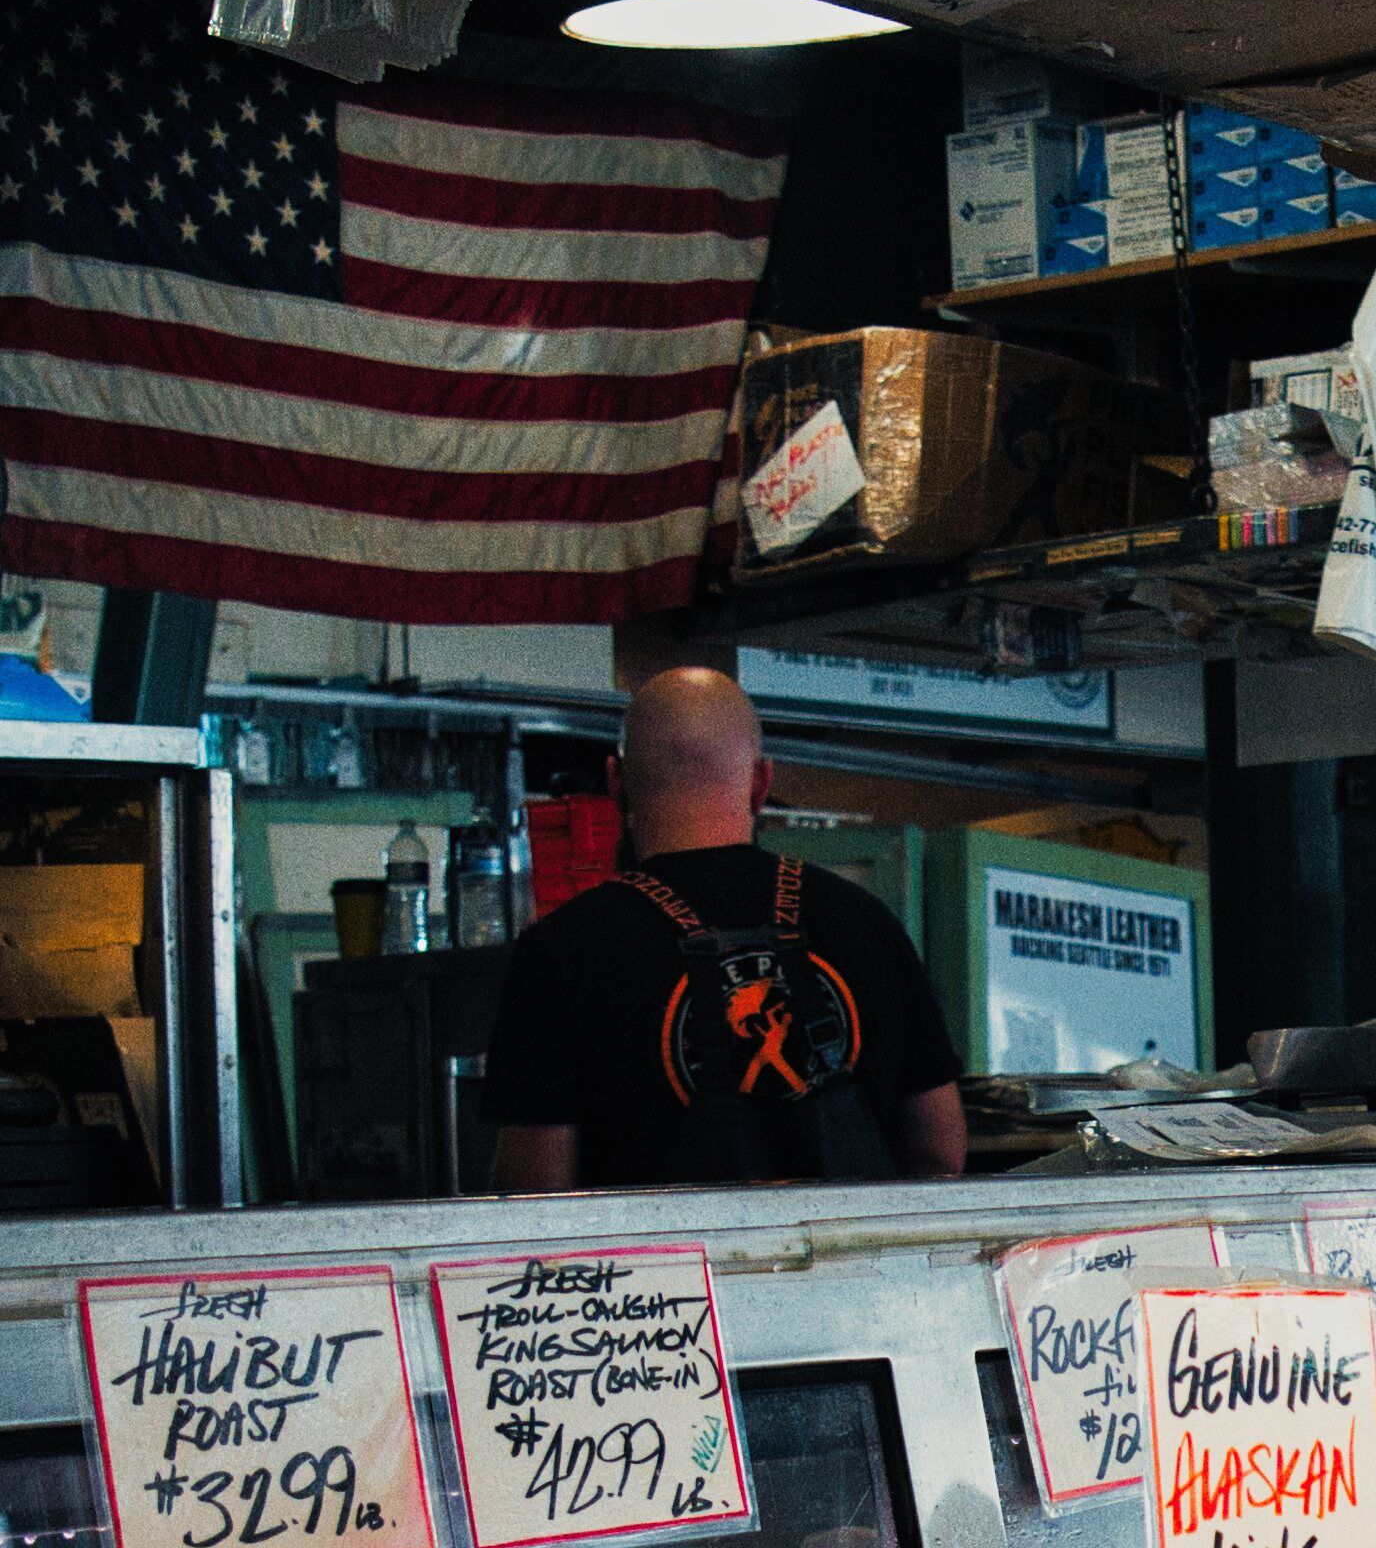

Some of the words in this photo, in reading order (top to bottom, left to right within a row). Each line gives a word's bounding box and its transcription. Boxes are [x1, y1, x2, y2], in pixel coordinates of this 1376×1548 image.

[994, 888, 1103, 942] MARAKESH
[1106, 904, 1182, 955] LEATHER
[486, 1366, 593, 1411] ROAST
[1168, 1306, 1371, 1422] GENUINE
[166, 1393, 319, 1460] ROAST
[144, 1445, 357, 1548] $32.99
[1165, 1415, 1358, 1535] ALASKAN
